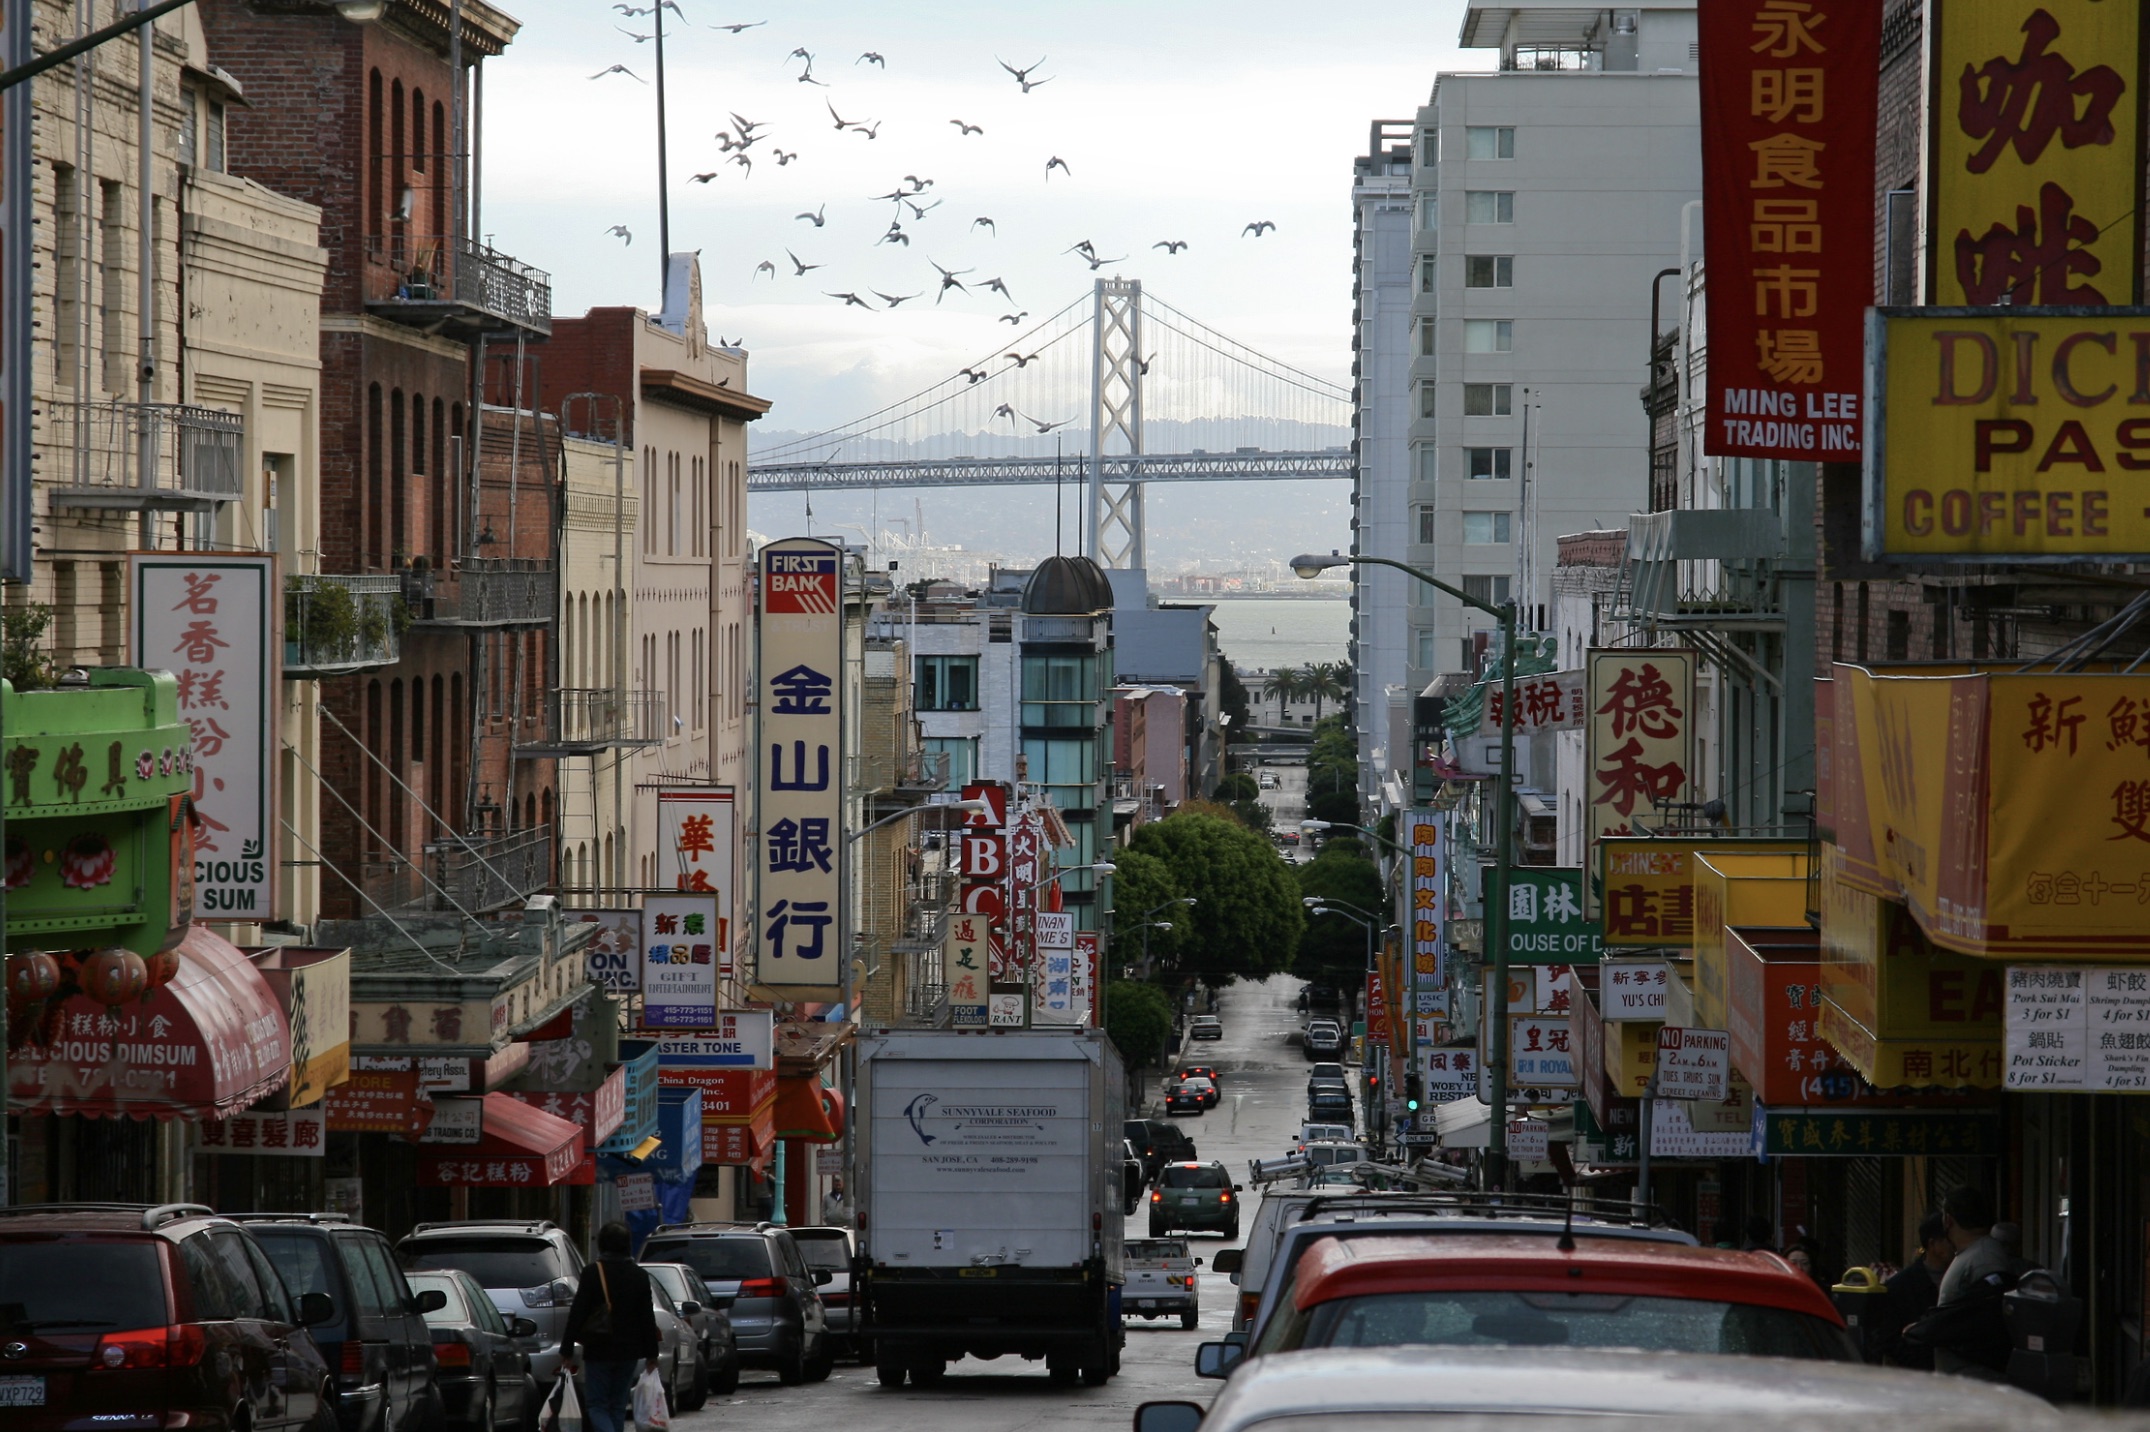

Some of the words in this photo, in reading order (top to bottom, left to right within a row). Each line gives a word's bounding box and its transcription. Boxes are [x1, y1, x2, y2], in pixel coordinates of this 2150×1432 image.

[1749, 0, 1827, 385] 永明食品市場
[1724, 387, 1796, 417] MING
[1806, 391, 1857, 420] LEE
[1724, 419, 1814, 449] TRADING
[1822, 424, 1861, 451] INC.
[1904, 489, 2109, 537] COFFEE
[771, 555, 834, 572] FIRST
[771, 575, 823, 592] BANK
[784, 620, 830, 633] TRUST
[766, 664, 833, 960] 金山銀行
[1610, 852, 1684, 876] CHINESE
[203, 889, 255, 910] SUM
[1510, 934, 1560, 951] OUSE
[1564, 934, 1587, 951] OF
[590, 953, 627, 970] ON
[953, 919, 979, 1000] 過足癮
[660, 972, 699, 982] GIFT
[2011, 971, 2081, 989] 豬肉燒賣
[648, 983, 712, 994] ENTERTAINMENT
[1622, 994, 1644, 1007] YU'S
[1648, 994, 1667, 1007] CHI
[2013, 994, 2037, 1004] Pork
[2041, 994, 2057, 1003] Sui
[2061, 993, 2080, 1003] Mai
[2089, 996, 2120, 1006] Shrimp
[954, 1006, 979, 1016] FOOT
[2022, 1009, 2029, 1020] 3
[2031, 1009, 2052, 1022] for
[2055, 1008, 2070, 1020] $1
[2103, 1009, 2111, 1020] 4
[2112, 1009, 2133, 1023] for
[990, 1015, 1022, 1024] RANT
[1523, 1025, 1570, 1053] 皇冠
[1661, 1030, 1680, 1047] NO
[1685, 1035, 1727, 1051] PARKING
[116, 1043, 197, 1066] DIMSUM
[703, 1042, 742, 1053] TONE
[2012, 1055, 2033, 1066] Pot
[2036, 1055, 2081, 1068] Sticker
[657, 1076, 684, 1084] China
[688, 1076, 724, 1086] Dragon
[2008, 1072, 2016, 1084] 8
[2018, 1072, 2038, 1086] for
[2042, 1072, 2056, 1084] $1
[2106, 1076, 2112, 1087] 4
[2113, 1076, 2132, 1088] for
[2135, 1076, 2147, 1087] $1
[1431, 1082, 1463, 1091] WOEY
[1662, 1086, 1686, 1096] STREET
[1689, 1089, 1721, 1099] CLEANING
[942, 1107, 1004, 1117] SUNNYVALE
[1007, 1107, 1056, 1117] SEAFOOD
[1609, 1108, 1635, 1124] NEW
[1714, 1111, 1745, 1125] TEL
[969, 1118, 1029, 1126] CORPORATION
[1509, 1121, 1521, 1134] NO
[1522, 1123, 1547, 1133] PARKING
[434, 1128, 462, 1138] TRADING
[1613, 1133, 1635, 1158] 新
[922, 1155, 940, 1164] SAN
[966, 1155, 978, 1164] CA
[936, 1165, 1026, 1174] www.sunnyvaleseafood.com
[91, 1413, 137, 1421] SIENNA
